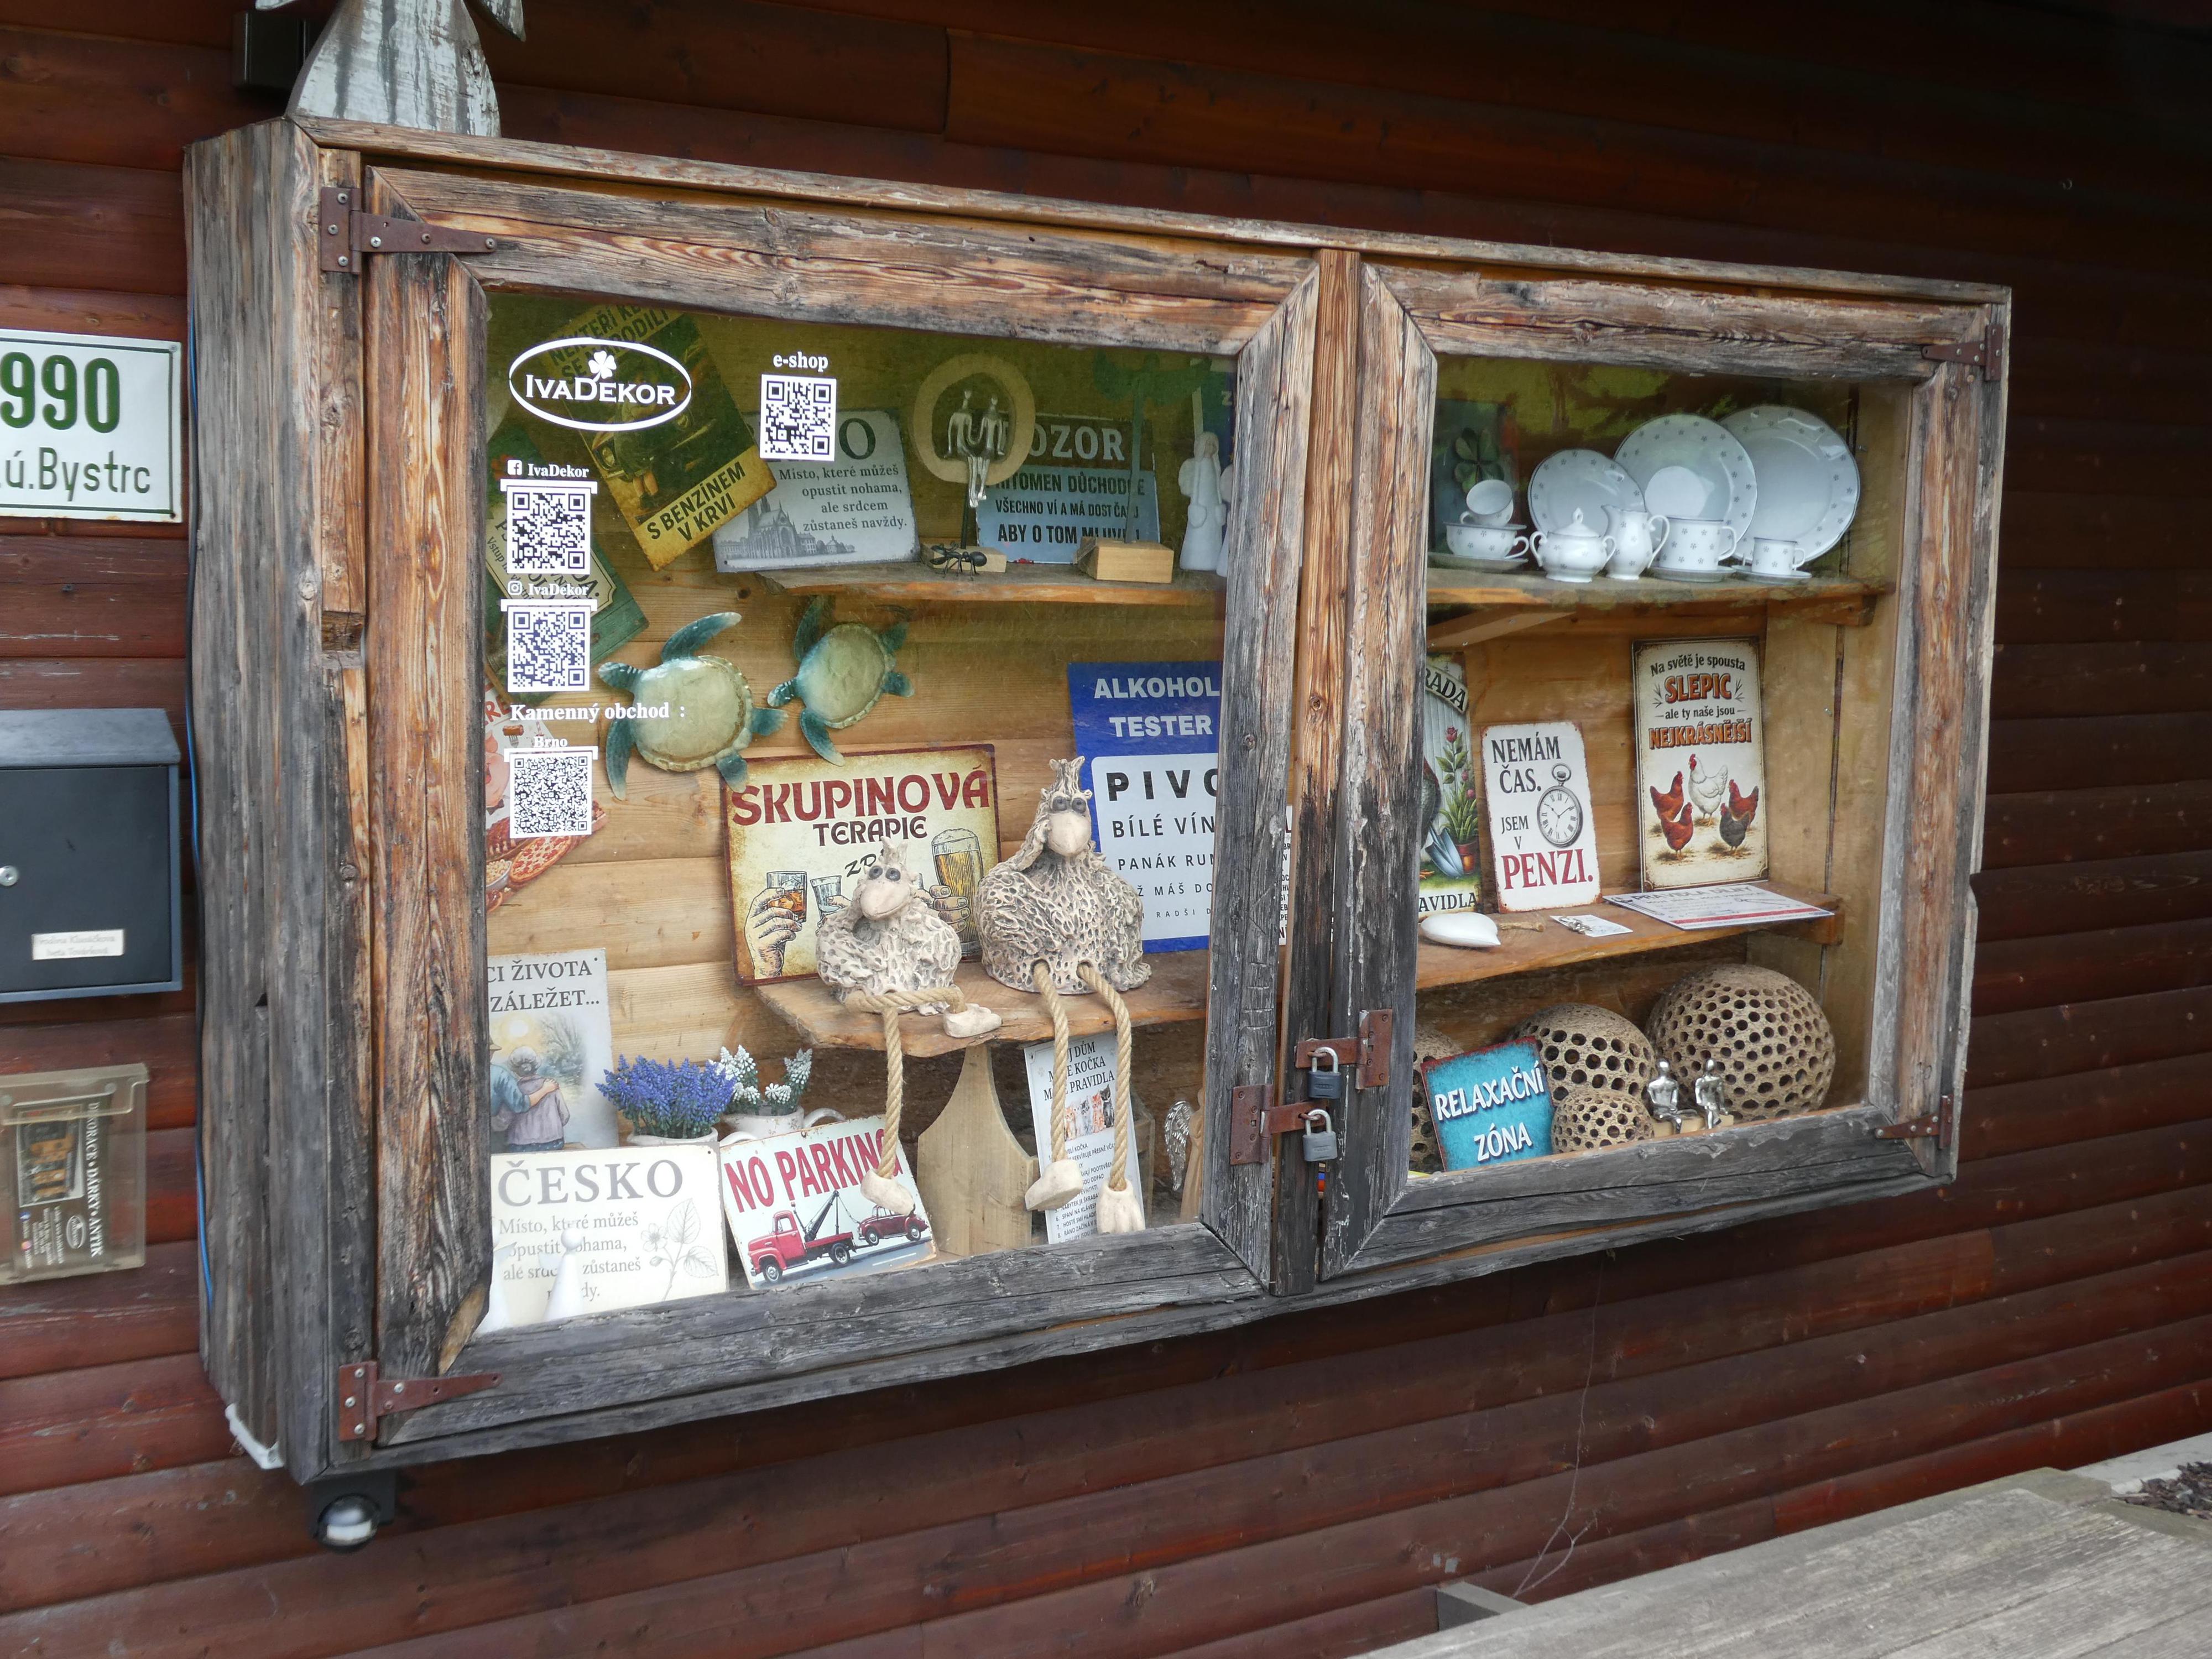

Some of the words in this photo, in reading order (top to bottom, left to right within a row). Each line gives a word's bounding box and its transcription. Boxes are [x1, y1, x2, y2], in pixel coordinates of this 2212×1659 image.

[773, 351, 828, 372] e-shop
[0, 352, 120, 433] 990
[1027, 424, 1125, 461] OZOR
[1, 447, 150, 501] ú.Bystrc
[528, 463, 589, 478] IvaDekor
[823, 466, 856, 479] které
[860, 465, 899, 477] můžeš
[802, 483, 847, 499] opustit
[851, 482, 902, 494] nohama,
[1068, 472, 1145, 495] DŮCHODE
[677, 522, 692, 541] V
[693, 493, 735, 532] KRVI
[821, 500, 839, 513] ale
[843, 499, 888, 512] srdcem
[996, 497, 1043, 514] VŠECHNO
[1047, 498, 1057, 515] VÍ
[1061, 502, 1067, 515] A
[1070, 500, 1085, 516] MÁ
[1088, 504, 1111, 517] DOST
[647, 522, 660, 539] S
[803, 518, 858, 531] zůstaneš
[862, 516, 907, 531] navždy.
[998, 524, 1027, 542] ABY
[1032, 525, 1042, 542] O
[1046, 525, 1077, 544] TOM
[487, 536, 504, 562] Vstup
[528, 583, 589, 596] IvaDekor
[1650, 663, 1665, 677] Na
[1668, 654, 1693, 670] světě
[1695, 654, 1704, 669] je
[1707, 656, 1745, 671] spousta
[1094, 676, 1220, 698] ALKOHOL
[1426, 667, 1466, 711] RADA
[1664, 673, 1732, 704] SLEPIC
[510, 703, 600, 723] Kamenný
[604, 702, 670, 719] obchod
[1665, 709, 1679, 719] ale
[1682, 708, 1691, 720] ty
[1693, 706, 1713, 717] naše
[1716, 706, 1735, 718] jsou
[1109, 714, 1213, 738] TESTER
[1648, 718, 1752, 750] NEJKRÁSNĚJŠÍ
[534, 736, 568, 748] Brno
[1491, 732, 1561, 763] NEMÁM
[1499, 764, 1542, 794] ČAS.
[732, 764, 990, 826] SKUPINOVÁ
[813, 816, 927, 846] TERAPIE
[1112, 813, 1165, 838] BÍLÉ
[1173, 811, 1215, 834] VÍN
[1501, 815, 1529, 834] JSEM
[1514, 836, 1522, 850] V
[1118, 852, 1176, 870] PANÁK
[1501, 849, 1593, 890] PENZI.
[1155, 882, 1185, 896] MÁŠ
[1195, 883, 1212, 893] DO
[1156, 908, 1195, 918] RADŠI
[1419, 892, 1478, 912] AVIDLA
[512, 959, 592, 981] ŽIVOTA
[490, 987, 599, 1013] ZÁLEŽET...
[1074, 1040, 1096, 1058] DŮM
[1074, 1056, 1106, 1074] KOČKA
[1070, 1070, 1115, 1093] PRAVIDLA
[1434, 1060, 1544, 1121] RELAXAČNÍ
[1474, 1123, 1532, 1162] ZÓNA
[498, 1160, 683, 1207] ČESKO
[724, 1156, 774, 1213] NO
[499, 1218, 547, 1234] Místo,
[593, 1211, 639, 1228] můžeš
[504, 1264, 524, 1280] ale
[582, 1256, 641, 1275] zůstaneš
